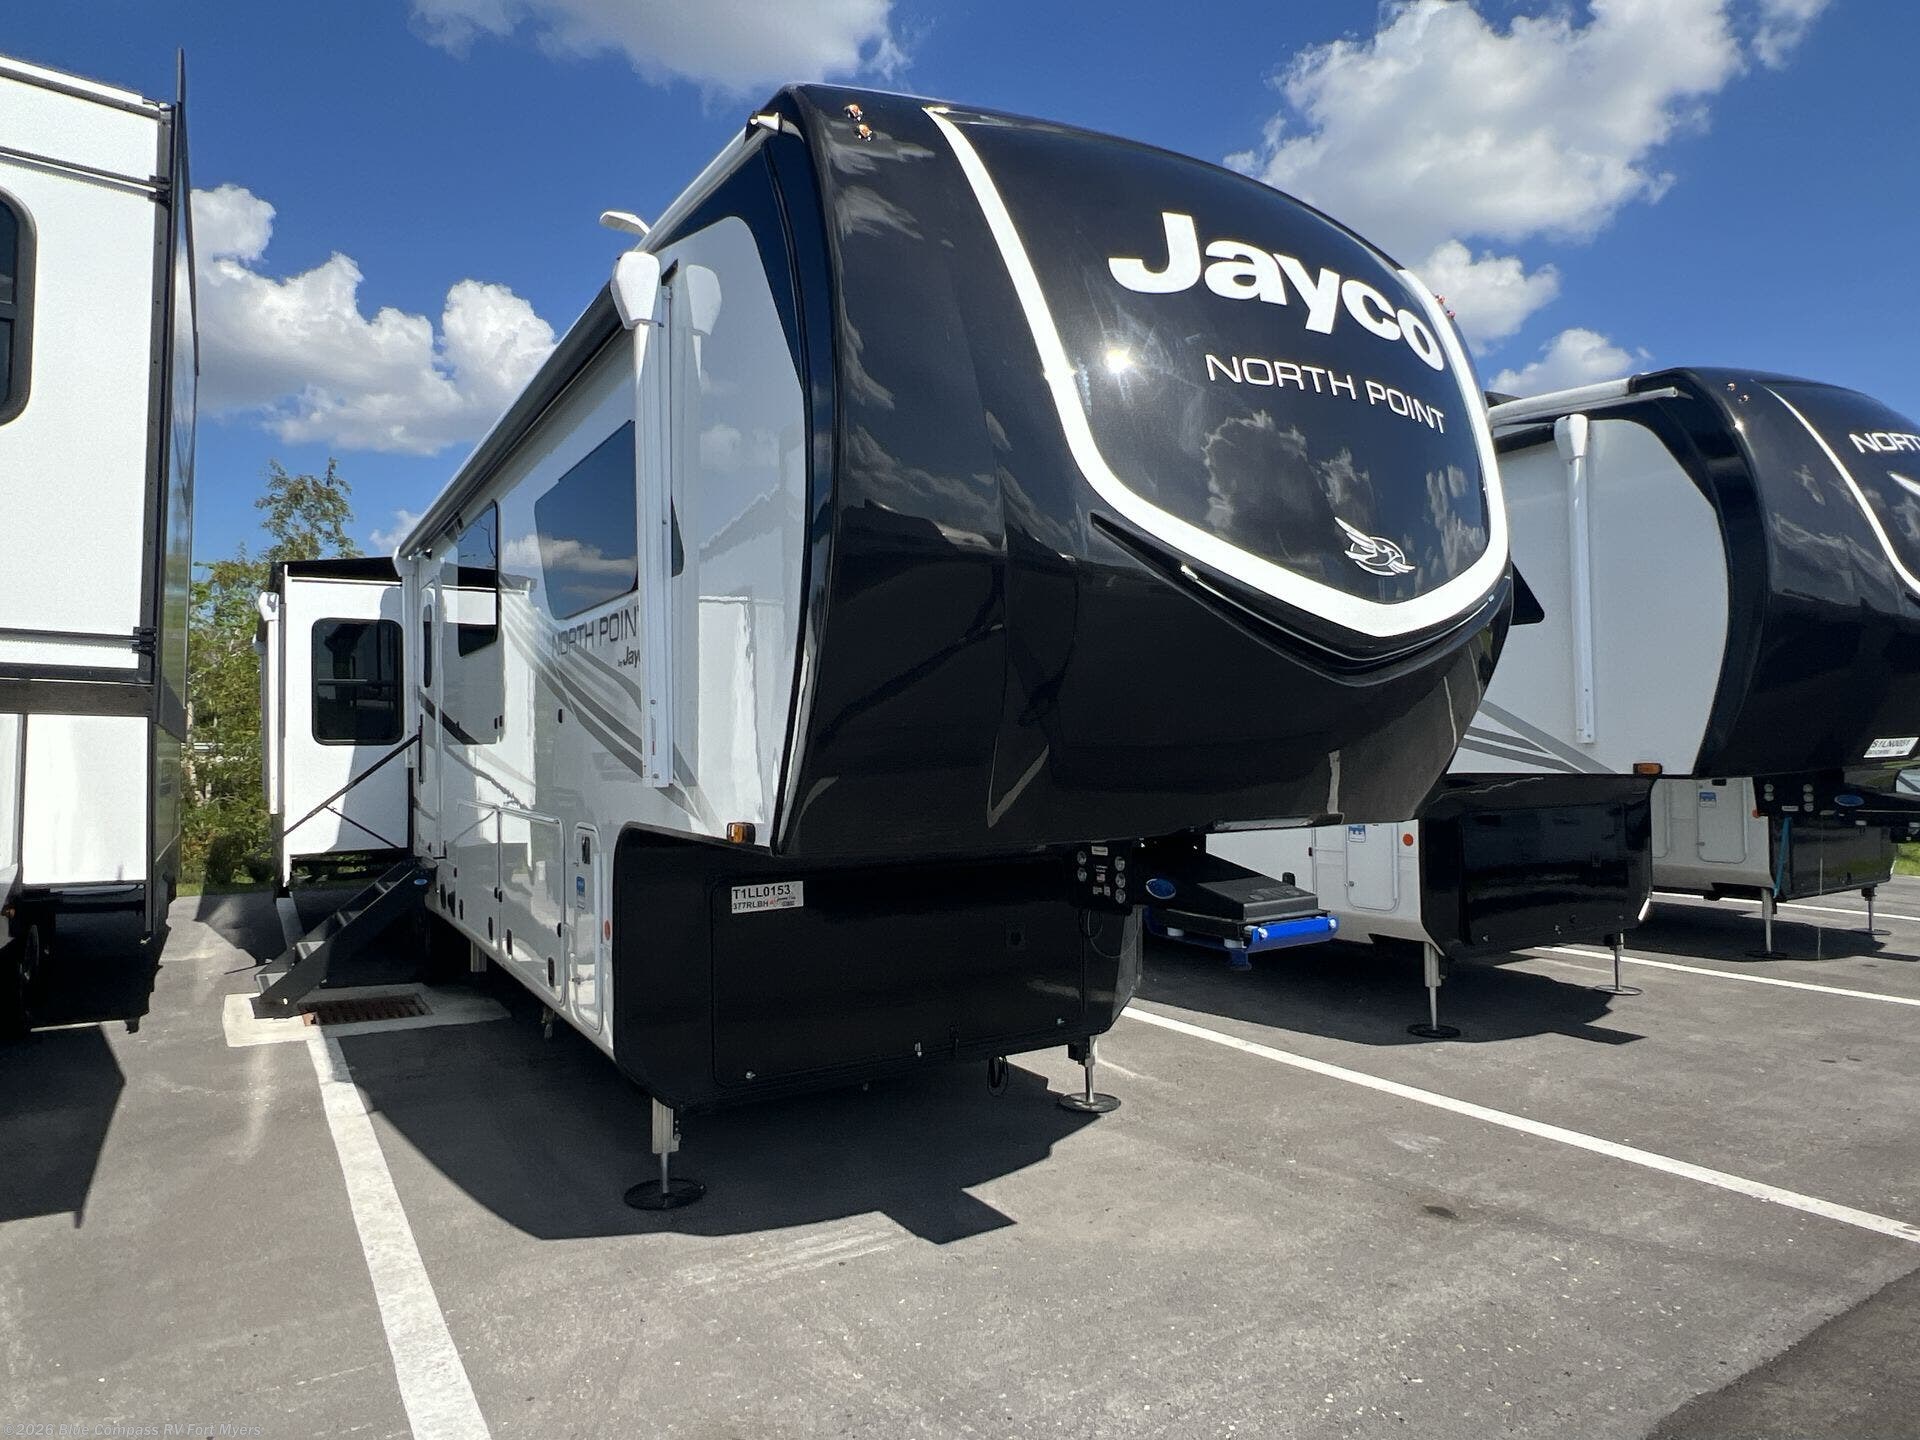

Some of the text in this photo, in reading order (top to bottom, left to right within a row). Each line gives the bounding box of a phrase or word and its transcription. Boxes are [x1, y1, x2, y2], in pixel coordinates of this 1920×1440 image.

[1108, 212, 1444, 371] Jayco
[1205, 354, 1445, 433] NORTH POINT
[552, 605, 639, 656] NORTH POIN
[623, 646, 640, 668] Jay
[733, 885, 791, 899] T1LL0153
[733, 900, 769, 909] 377RLBH
